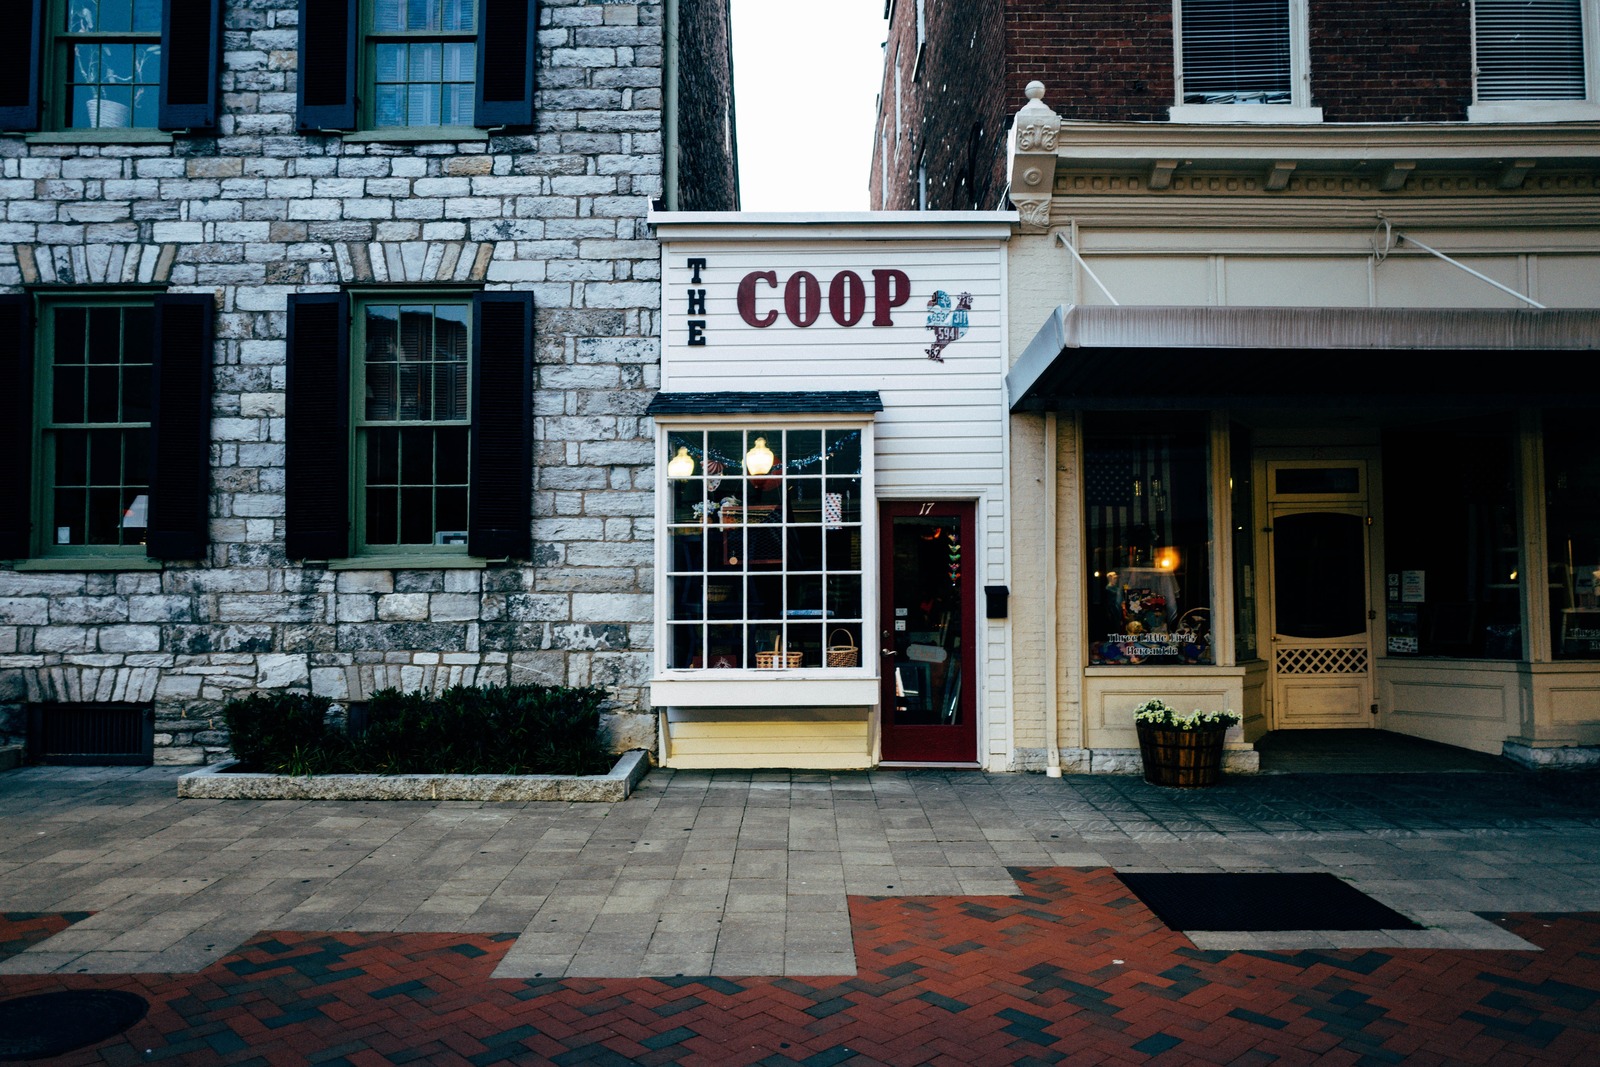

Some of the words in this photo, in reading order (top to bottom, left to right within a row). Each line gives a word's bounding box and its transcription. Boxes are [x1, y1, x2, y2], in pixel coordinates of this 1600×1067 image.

[687, 257, 706, 346] THE
[737, 269, 911, 328] COOP
[919, 502, 935, 515] 17
[1107, 632, 1138, 643] Three
[1139, 632, 1166, 643] Little
